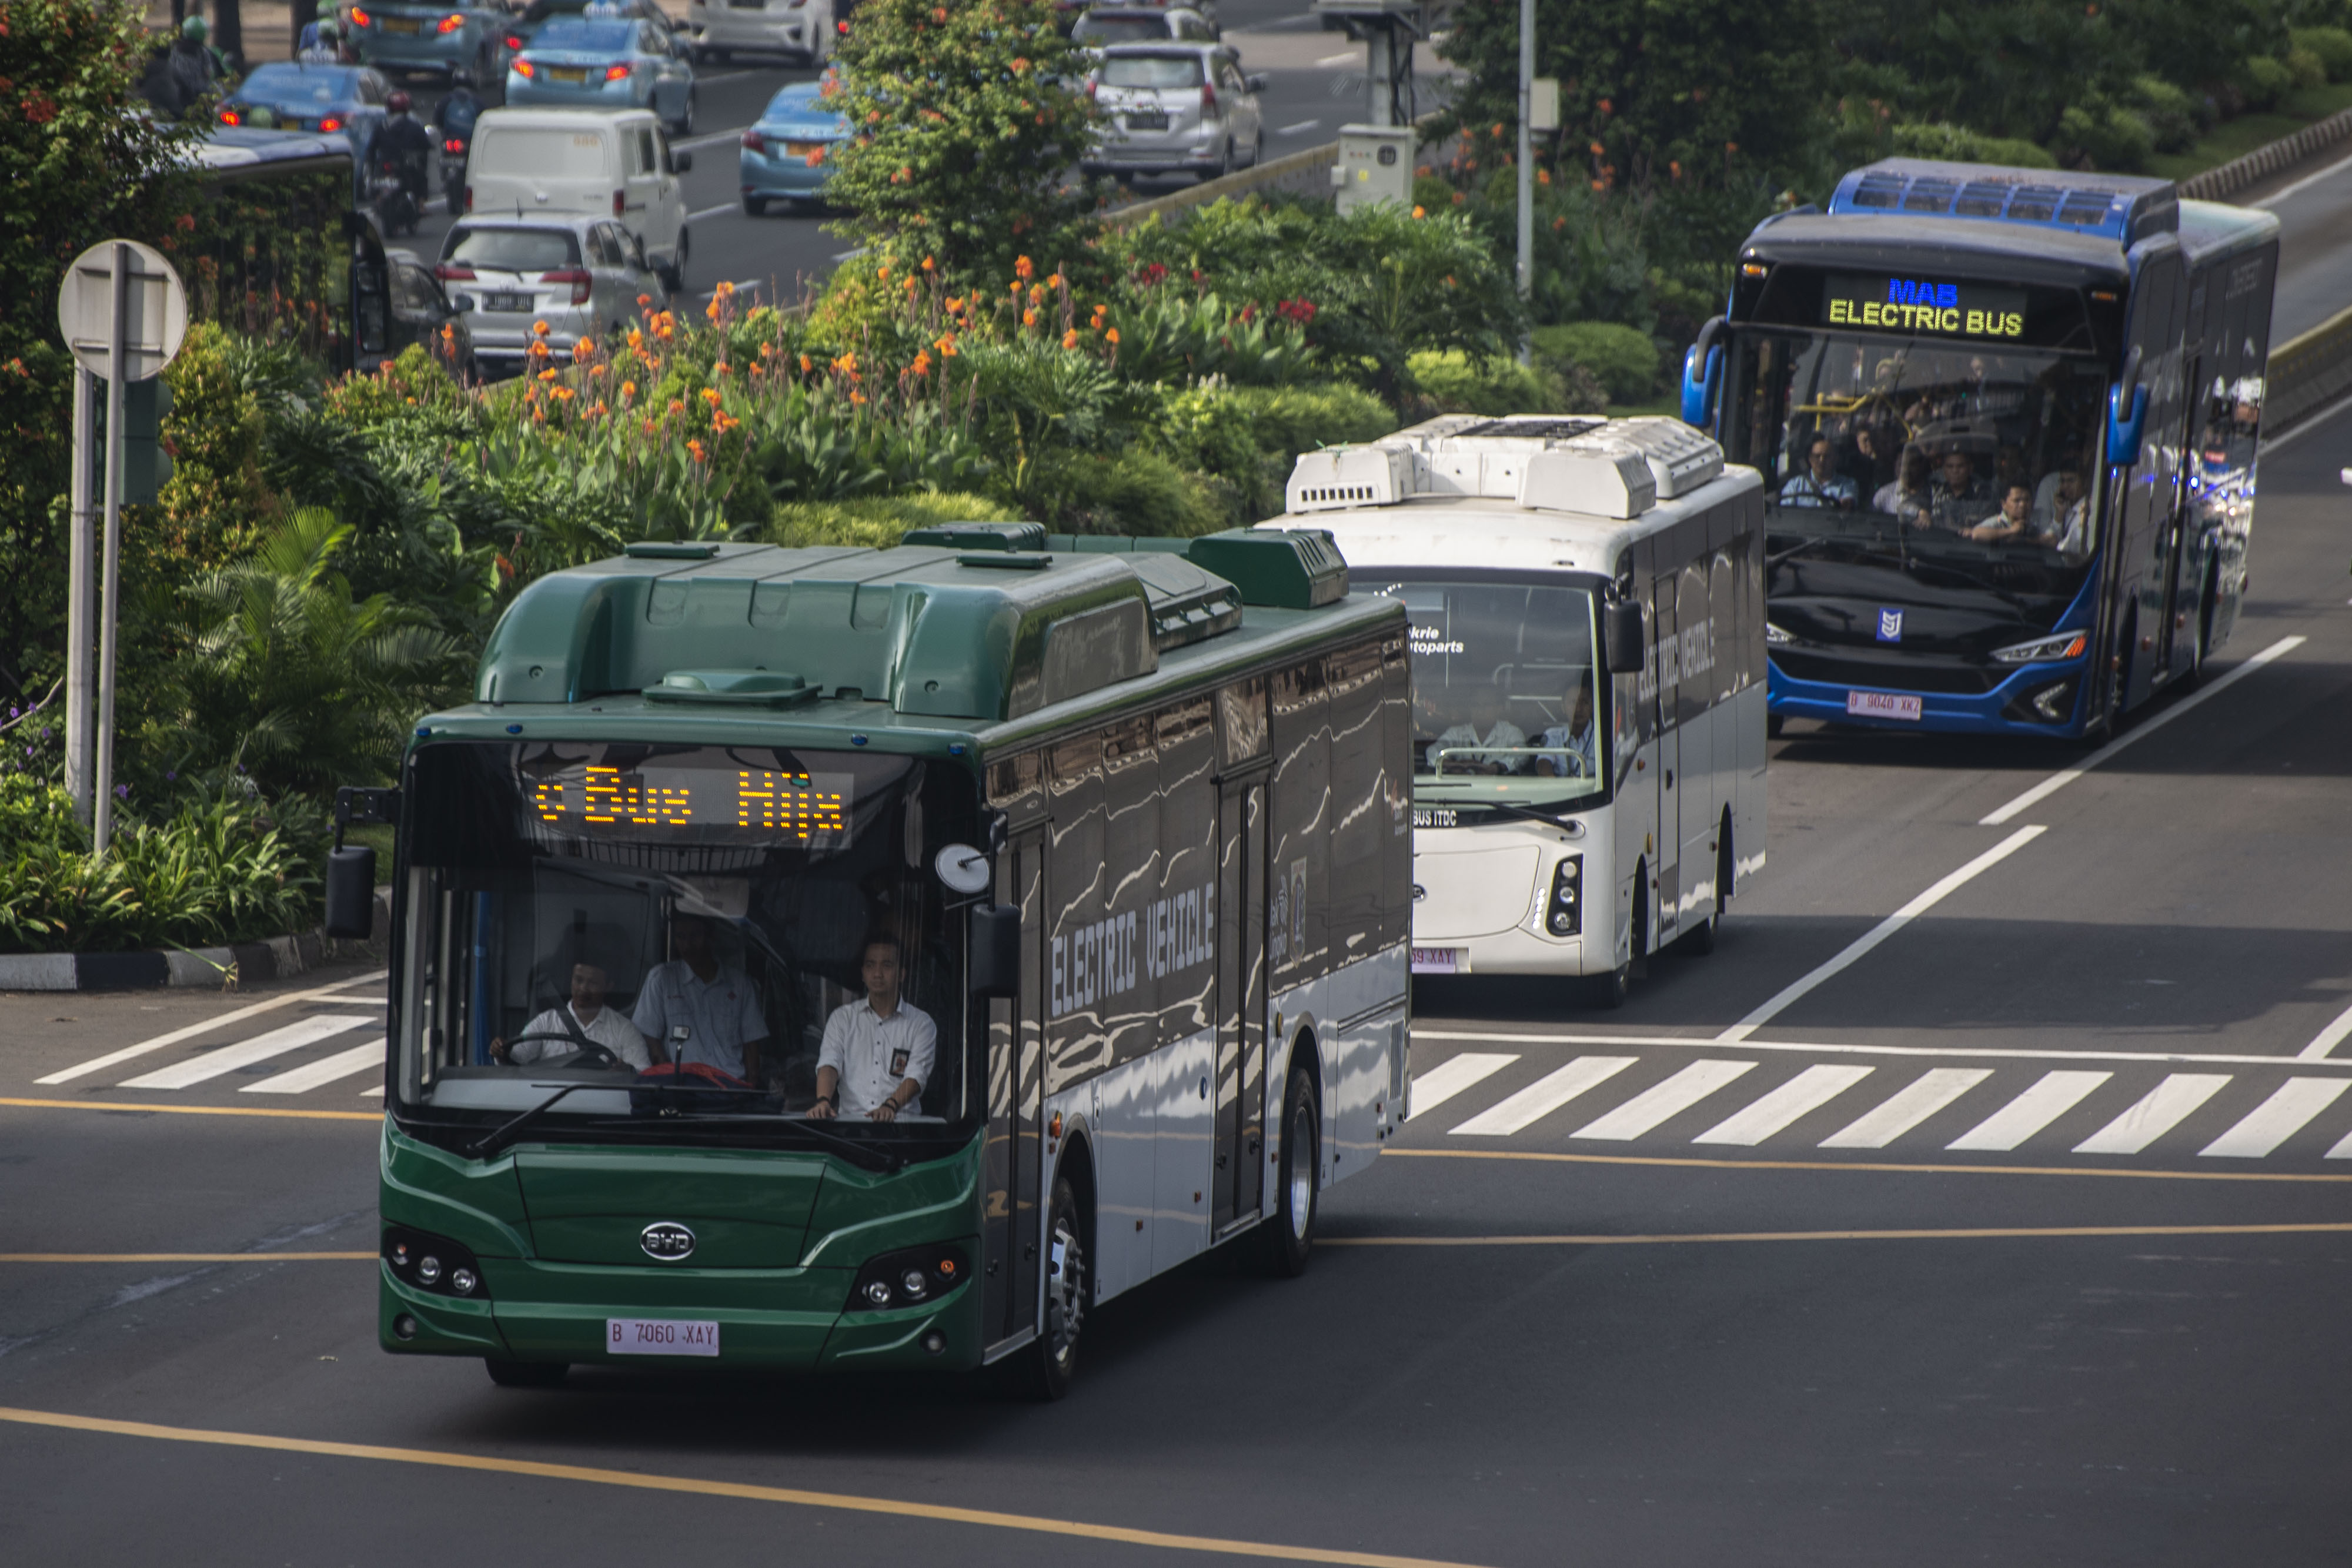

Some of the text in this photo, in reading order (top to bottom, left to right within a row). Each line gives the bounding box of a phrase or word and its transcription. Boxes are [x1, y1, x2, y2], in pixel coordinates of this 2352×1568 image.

[1888, 278, 1958, 307] MAB
[1829, 298, 2023, 336] ELECTRIC BUS
[1409, 626, 1439, 639] krie
[1411, 640, 1465, 656] toparts
[1681, 616, 1715, 681] VEHICLE
[586, 767, 691, 824] Bus
[1414, 810, 1431, 826] BUS
[1434, 810, 1456, 827] ITDC
[1051, 881, 1214, 1018] ELECTRIC VEHICLE
[1412, 948, 1452, 964] 59 XAY
[646, 1232, 689, 1250] BYD
[612, 1323, 714, 1345] B 7060 XAY
